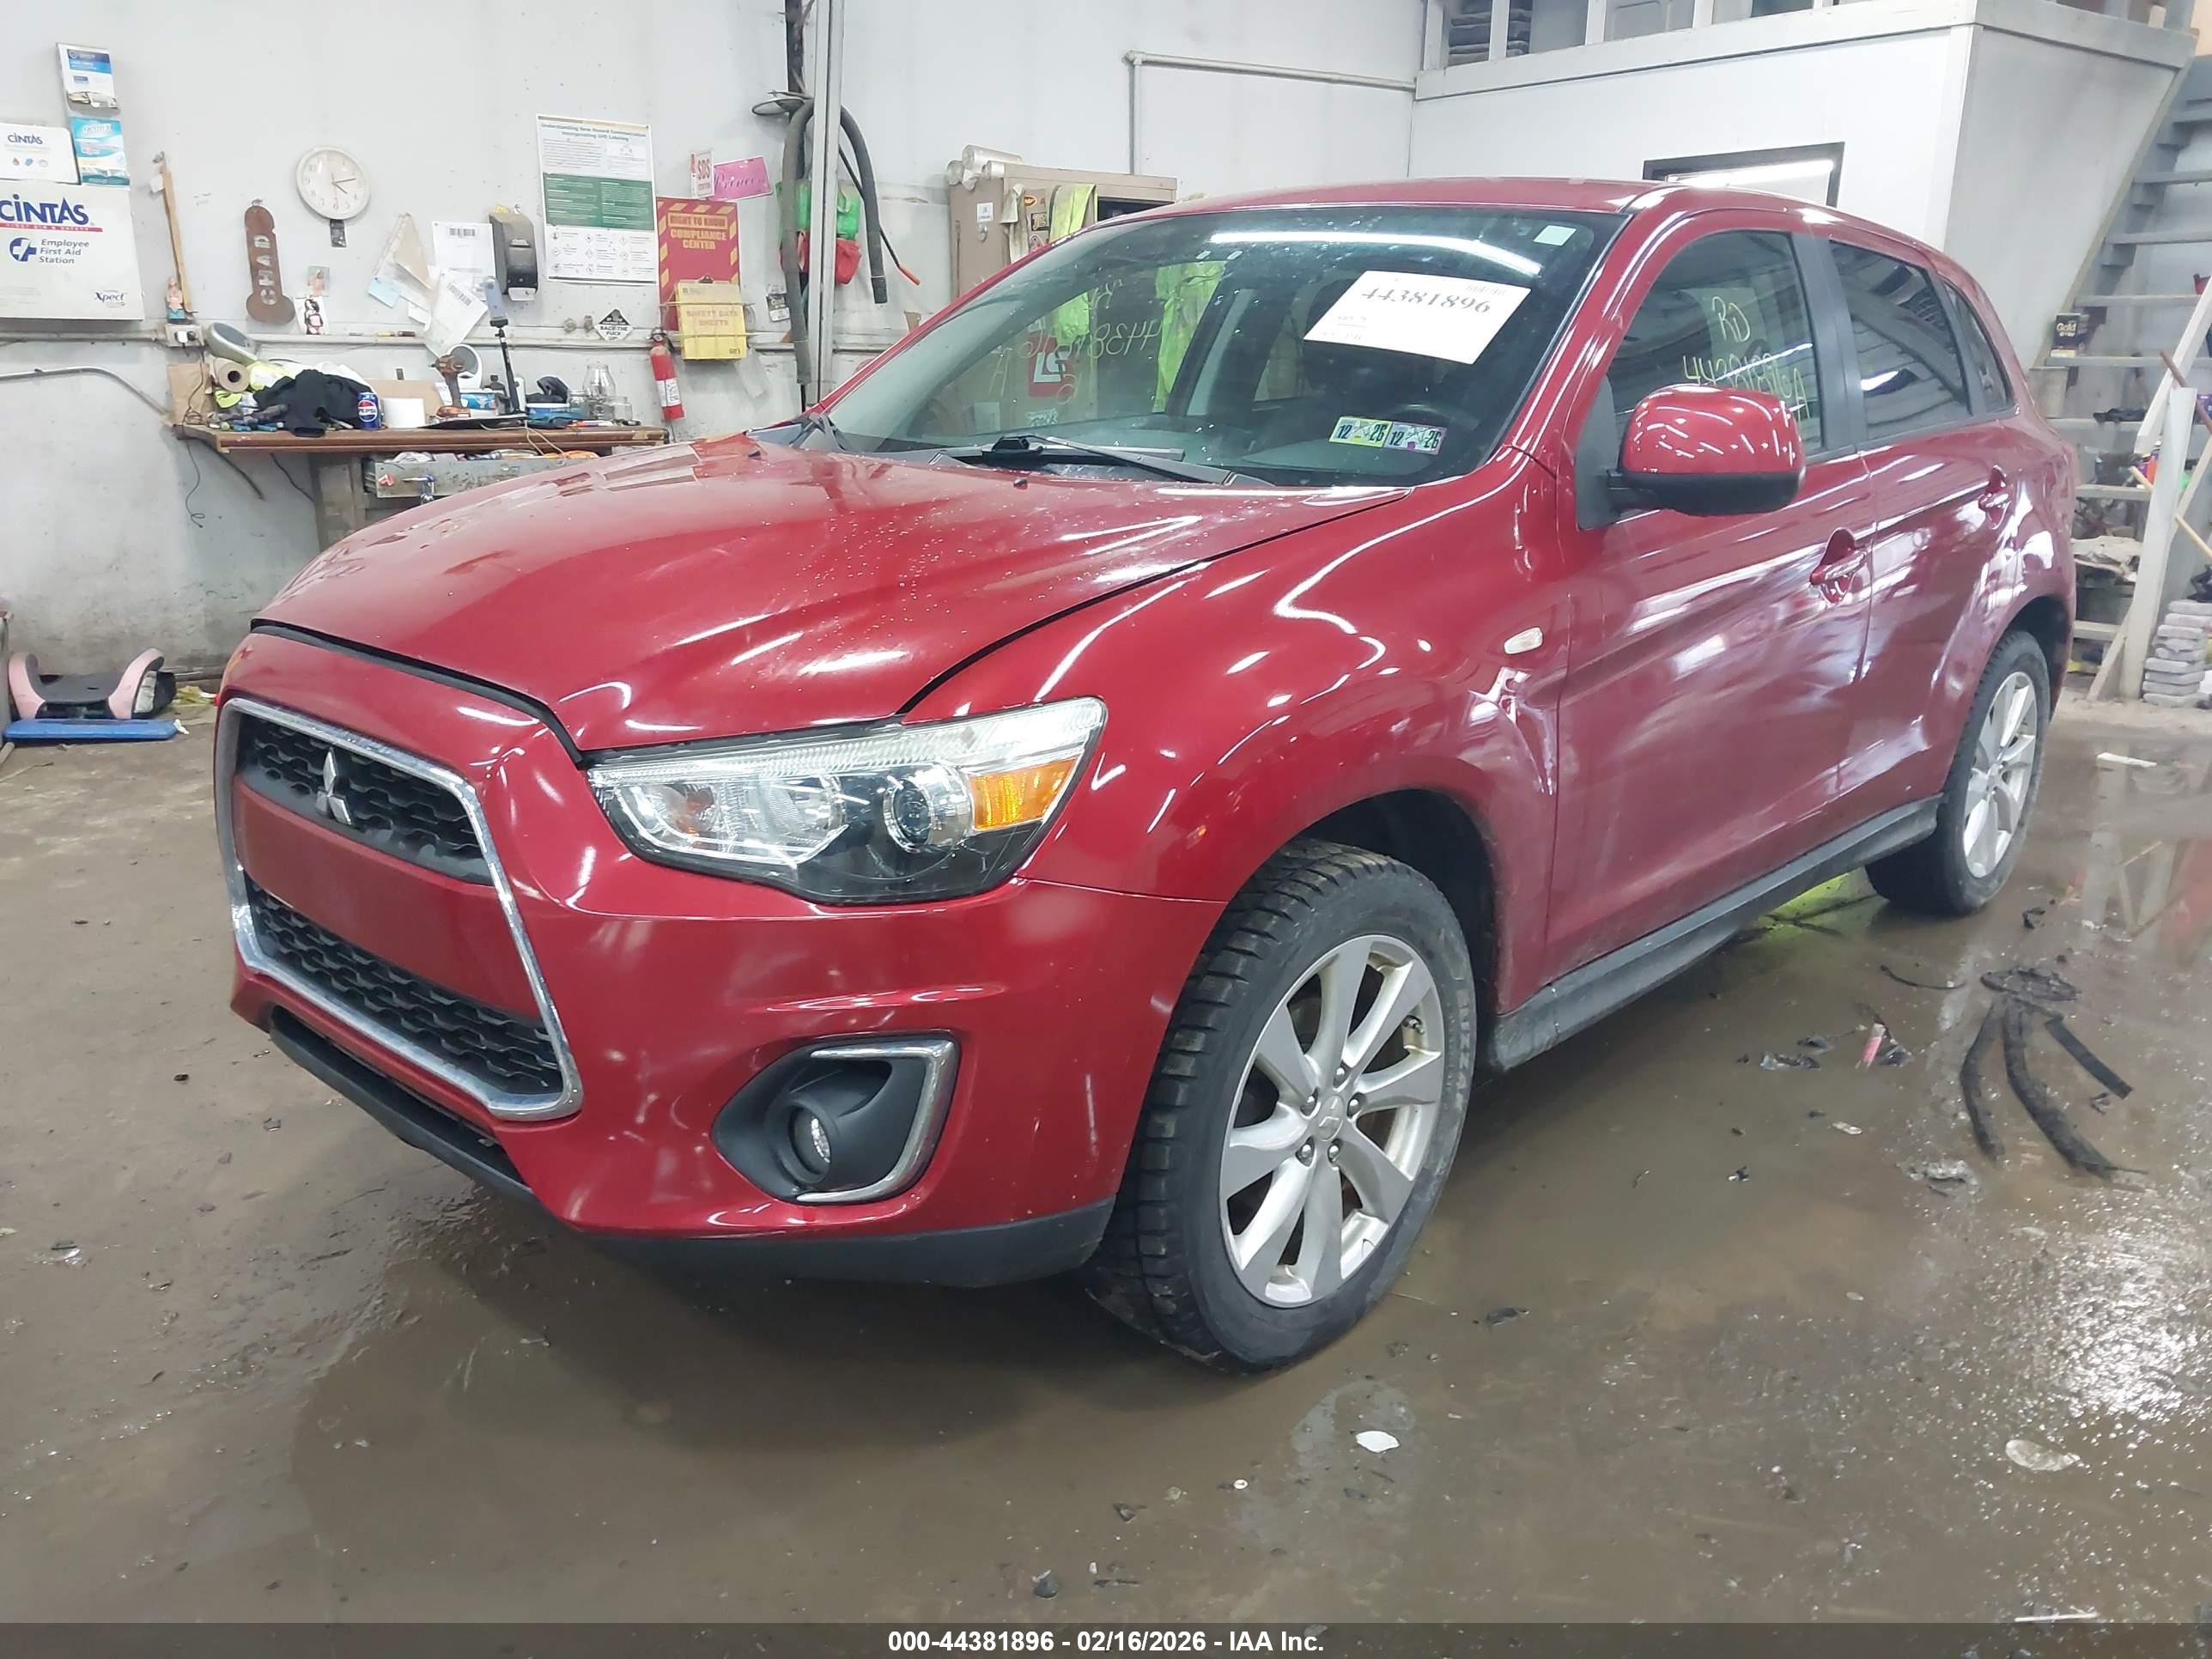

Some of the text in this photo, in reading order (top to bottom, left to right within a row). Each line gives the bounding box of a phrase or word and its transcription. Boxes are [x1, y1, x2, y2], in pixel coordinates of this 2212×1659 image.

[698, 158, 710, 180] SDS
[41, 239, 89, 248] Employee
[670, 228, 726, 240] COMPLIANCE
[683, 240, 715, 249] CENTER
[254, 234, 277, 306] CHAD
[1361, 288, 1491, 313] 44381896
[1712, 296, 1751, 342] RD
[1337, 423, 1388, 442] 12 26
[1389, 430, 1442, 449] 12 26
